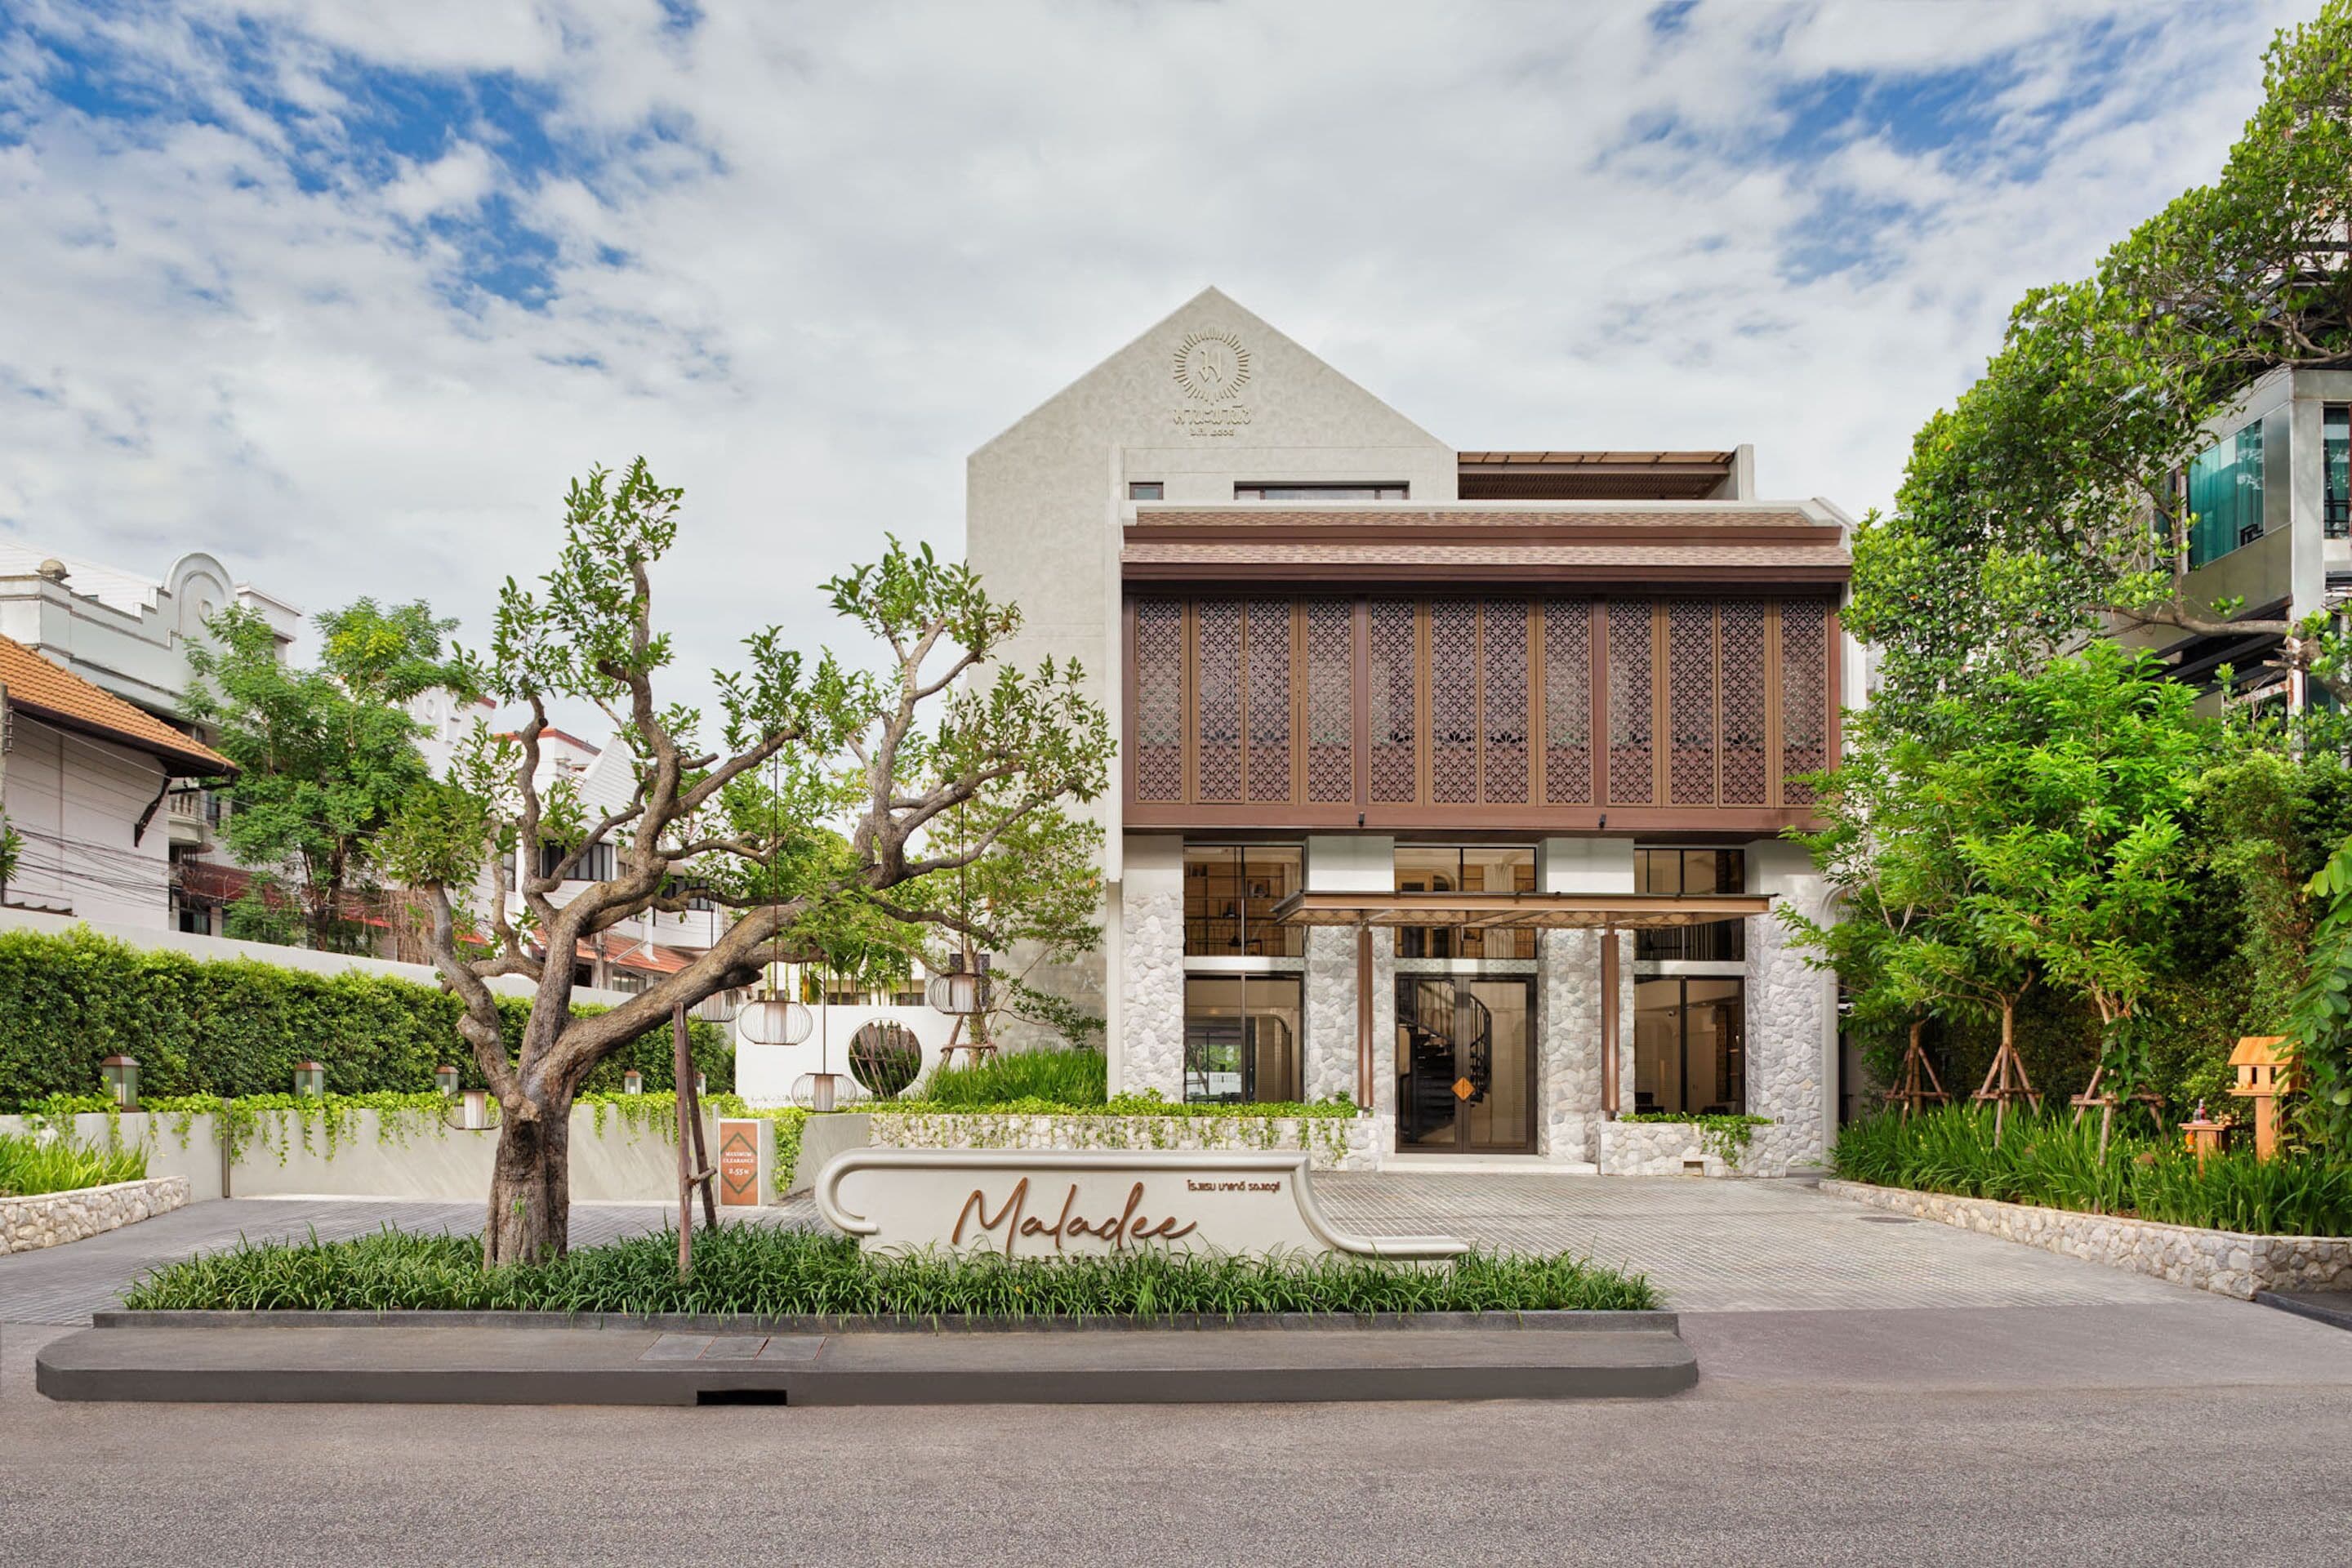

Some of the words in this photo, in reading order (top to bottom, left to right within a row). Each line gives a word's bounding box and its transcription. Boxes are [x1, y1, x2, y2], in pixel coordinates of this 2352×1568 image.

[1187, 1179, 1216, 1192] โรงแรม
[951, 1177, 1197, 1260] Maladee
